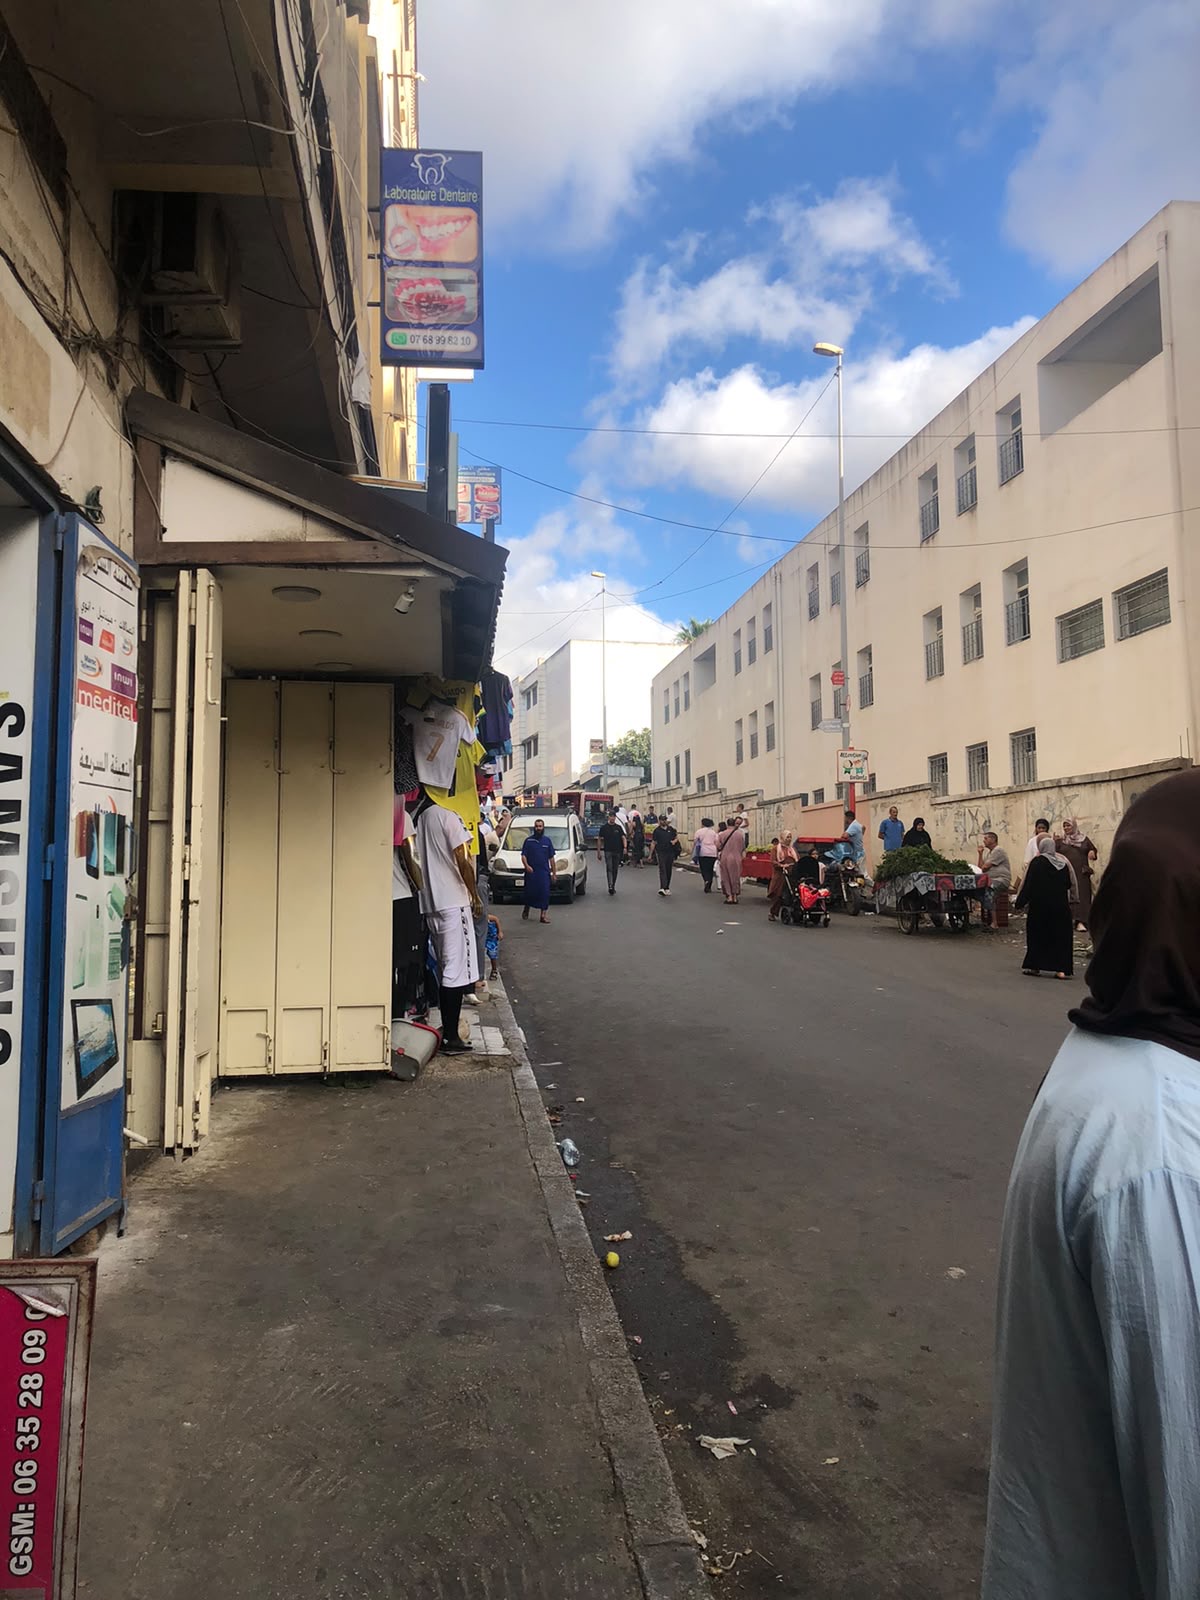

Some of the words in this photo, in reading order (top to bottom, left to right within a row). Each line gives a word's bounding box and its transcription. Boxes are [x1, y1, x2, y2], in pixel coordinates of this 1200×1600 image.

[384, 184, 437, 201] Laboratoire
[439, 187, 478, 203] Dentaire
[409, 334, 421, 344] 07
[422, 334, 434, 345] 68
[461, 335, 472, 346] 10
[426, 731, 445, 762] 7
[21, 1328, 47, 1364] 09
[18, 1371, 44, 1408] 28
[16, 1415, 42, 1451] 35
[13, 1458, 38, 1496] 06
[9, 1502, 36, 1577] GSM:
